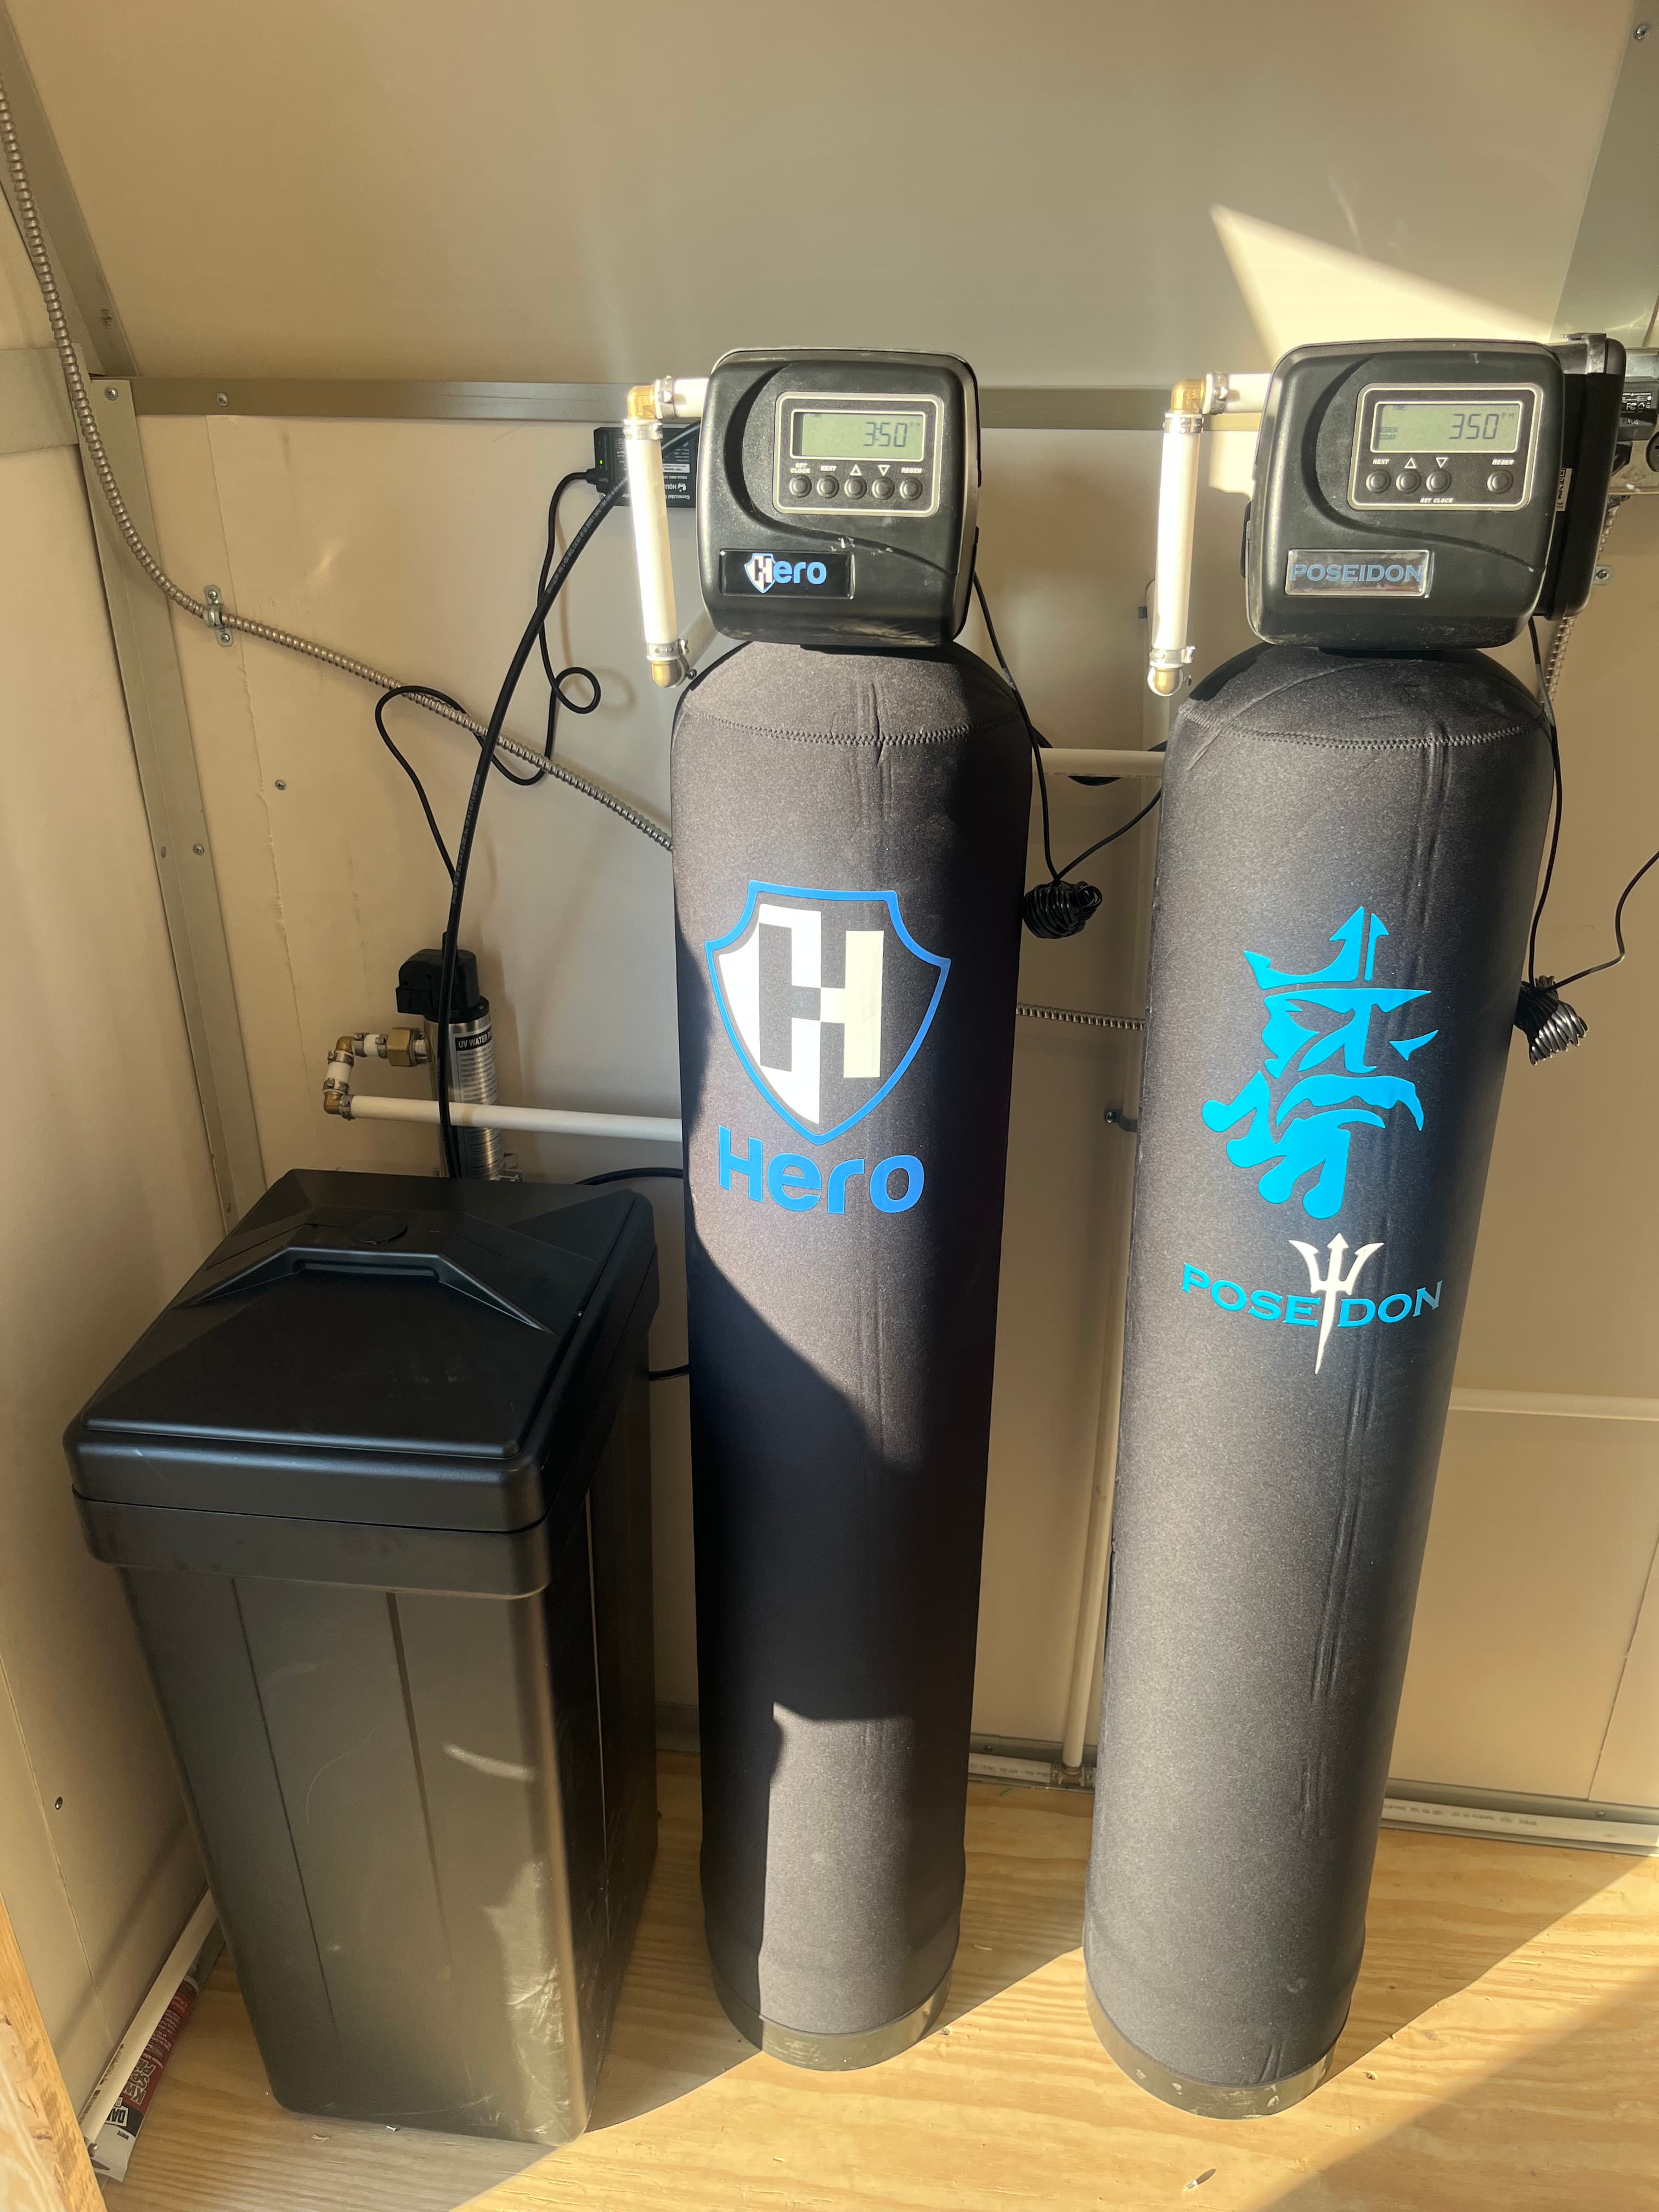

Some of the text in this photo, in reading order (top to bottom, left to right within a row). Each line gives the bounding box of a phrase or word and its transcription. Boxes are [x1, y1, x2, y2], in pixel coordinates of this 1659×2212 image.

[1291, 563, 1423, 583] POSEIDON
[458, 1040, 468, 1048] UV
[469, 1034, 488, 1046] WATER
[719, 1125, 925, 1215] Hero
[117, 2130, 129, 2140] WHITE
